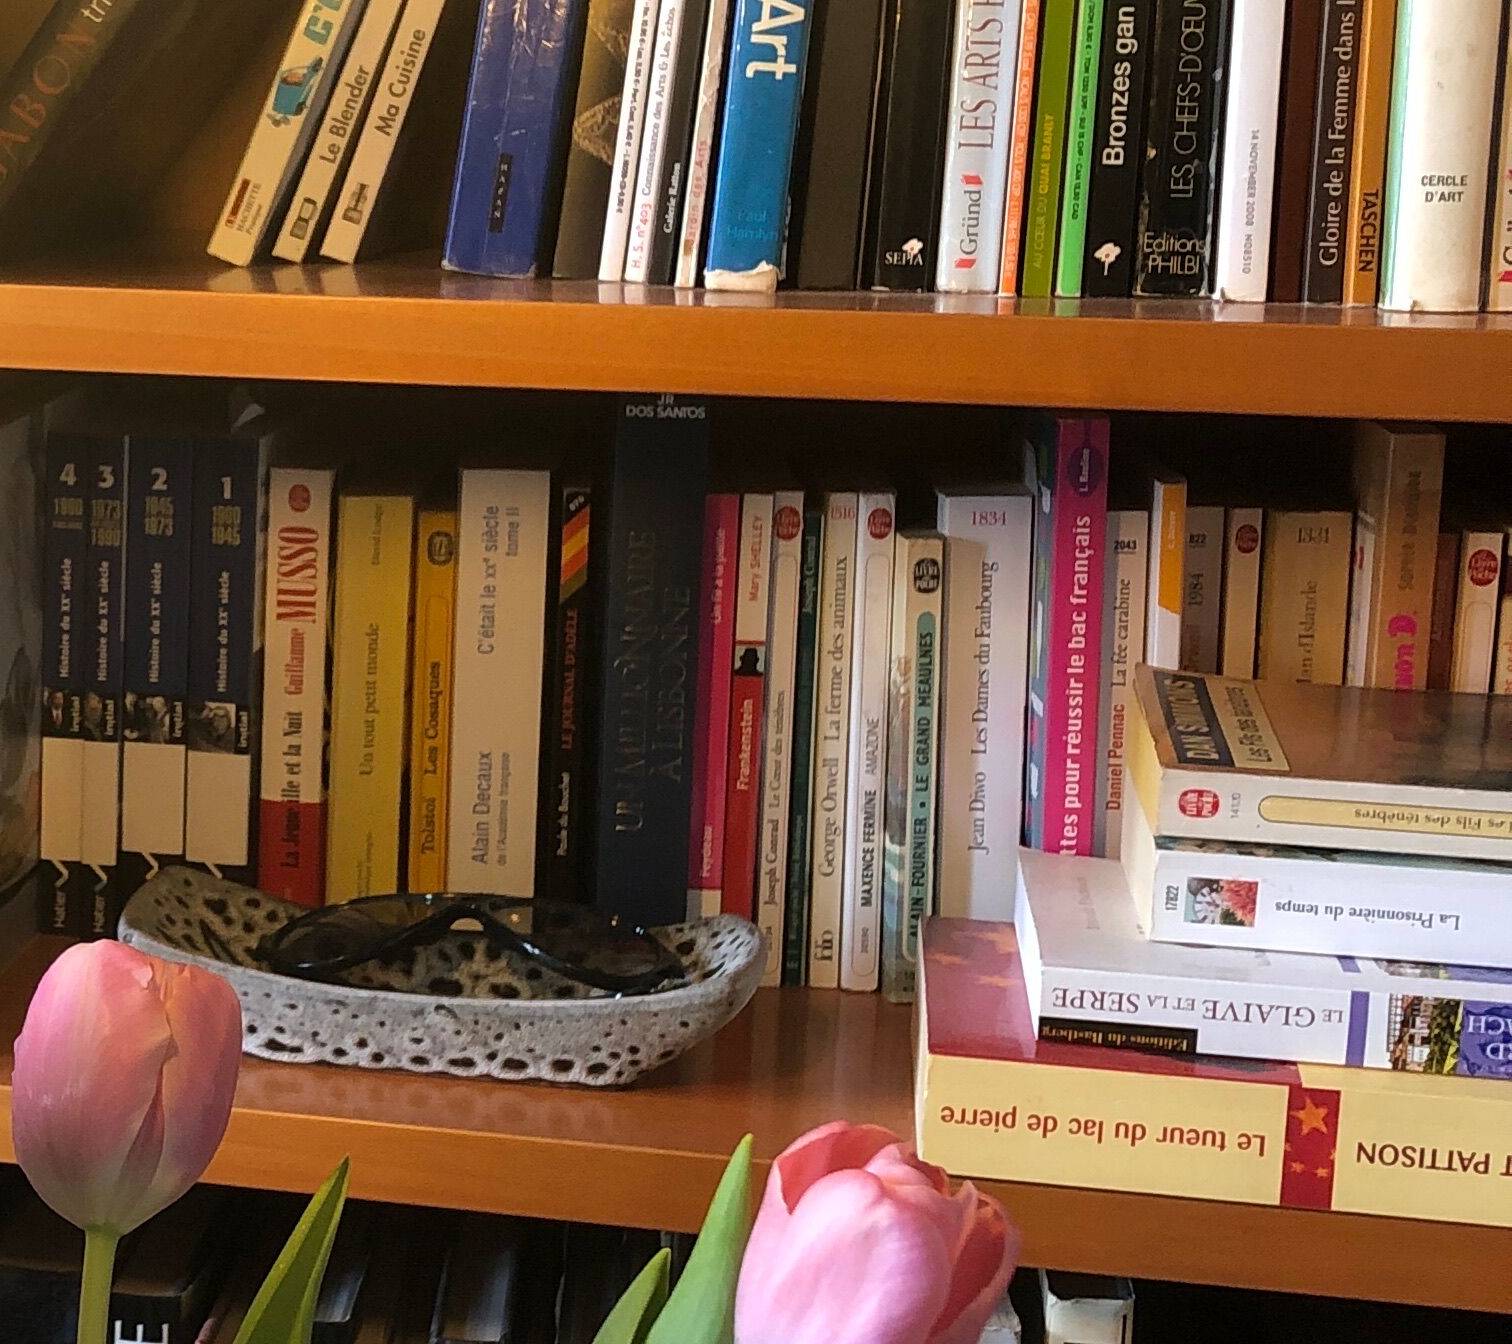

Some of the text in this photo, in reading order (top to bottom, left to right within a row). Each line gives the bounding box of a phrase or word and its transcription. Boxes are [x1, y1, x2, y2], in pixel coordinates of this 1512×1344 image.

[965, 13, 1004, 89] ARTS
[1115, 5, 1139, 57] gan
[1333, 11, 1356, 60] dans
[374, 27, 428, 138] Ma Cuisine
[1327, 64, 1352, 141] Femme
[318, 63, 372, 166] Le Blender
[958, 100, 995, 151] LES
[1101, 61, 1131, 168] Bronzes
[641, 123, 660, 197] Connaissance
[1169, 158, 1195, 199] LES
[1324, 146, 1346, 174] la
[1419, 174, 1469, 187] CERCLE
[1323, 175, 1344, 205] de
[1424, 190, 1464, 203] D'ART
[960, 188, 982, 256] Gründ
[1318, 205, 1341, 267] Gloire
[1358, 189, 1379, 273] TASCHEN
[59, 463, 77, 486] 4
[98, 466, 115, 489] 3
[150, 467, 168, 491] 2
[276, 525, 320, 624] MUSSO
[1068, 516, 1094, 654] bac français
[818, 555, 848, 878] George Orwell La ferme des animaux
[915, 630, 935, 769] GRAND MEAULNES
[971, 644, 990, 755] Les Dames du
[1105, 578, 1131, 811] Daniel Pennac carabine
[471, 751, 492, 864] Alain Decaux
[862, 788, 877, 843] FERMINE
[1275, 898, 1460, 930] La du temps
[1051, 986, 1316, 1029] GLAIVE SERPE
[939, 1106, 1267, 1157] Le tueur du lac de pierre
[1355, 1141, 1490, 1176] PATTISON
